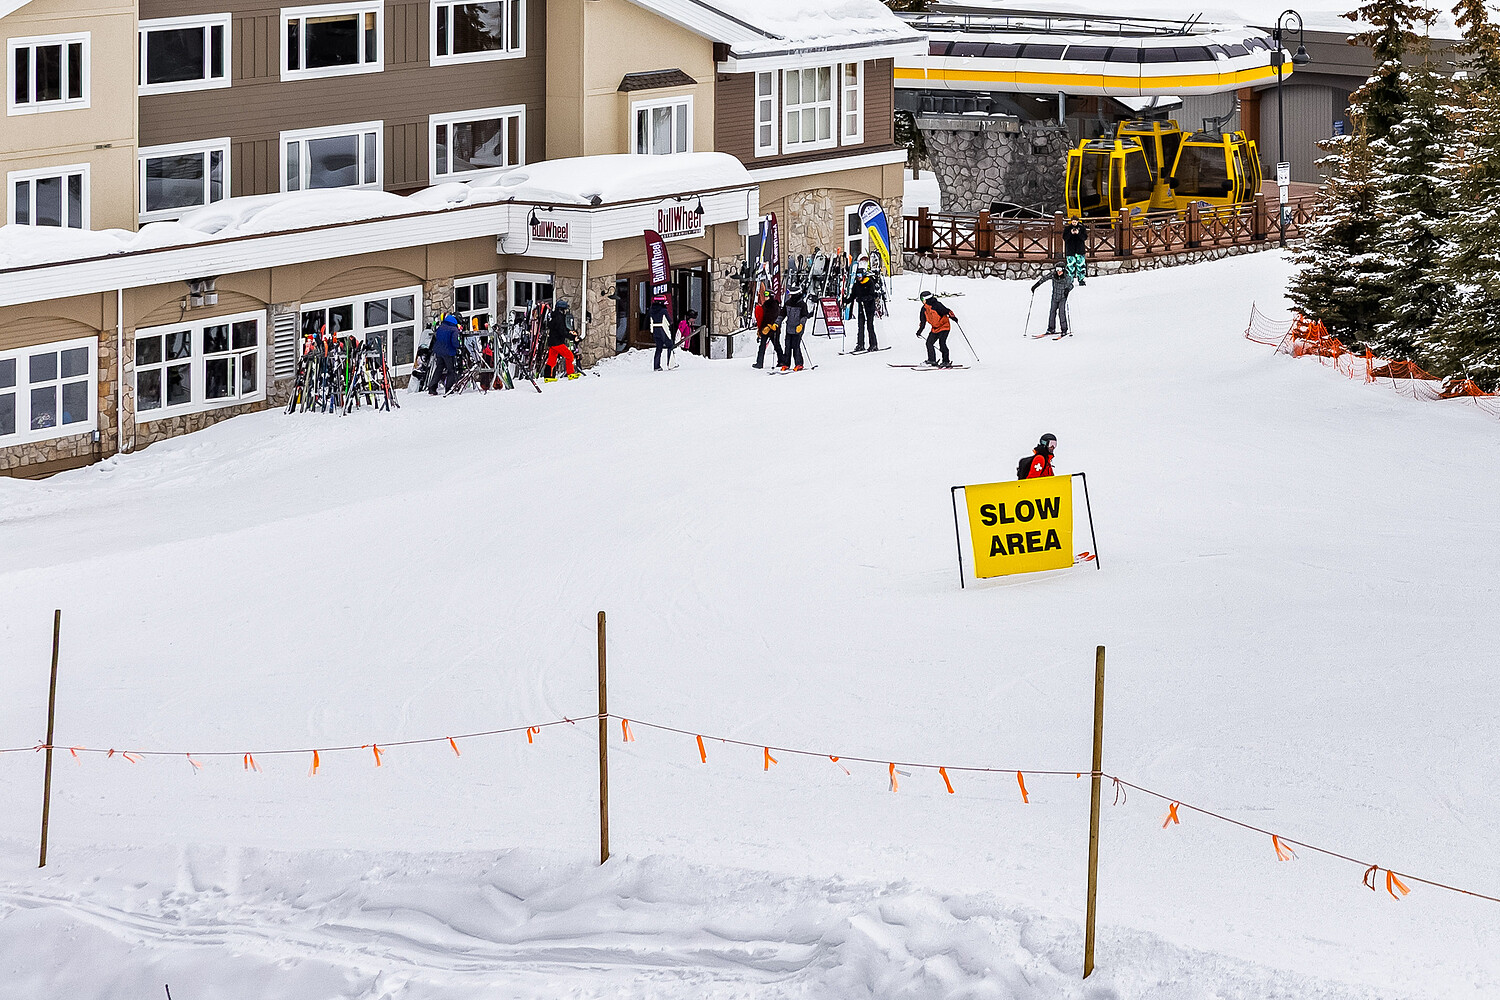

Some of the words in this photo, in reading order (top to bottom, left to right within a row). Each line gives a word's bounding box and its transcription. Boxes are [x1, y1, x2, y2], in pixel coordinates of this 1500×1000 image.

[531, 220, 569, 239] BullWheel
[657, 205, 702, 234] BullWheel
[649, 241, 665, 283] BullWheel
[980, 496, 1061, 526] SLOW
[989, 528, 1062, 557] AREA
